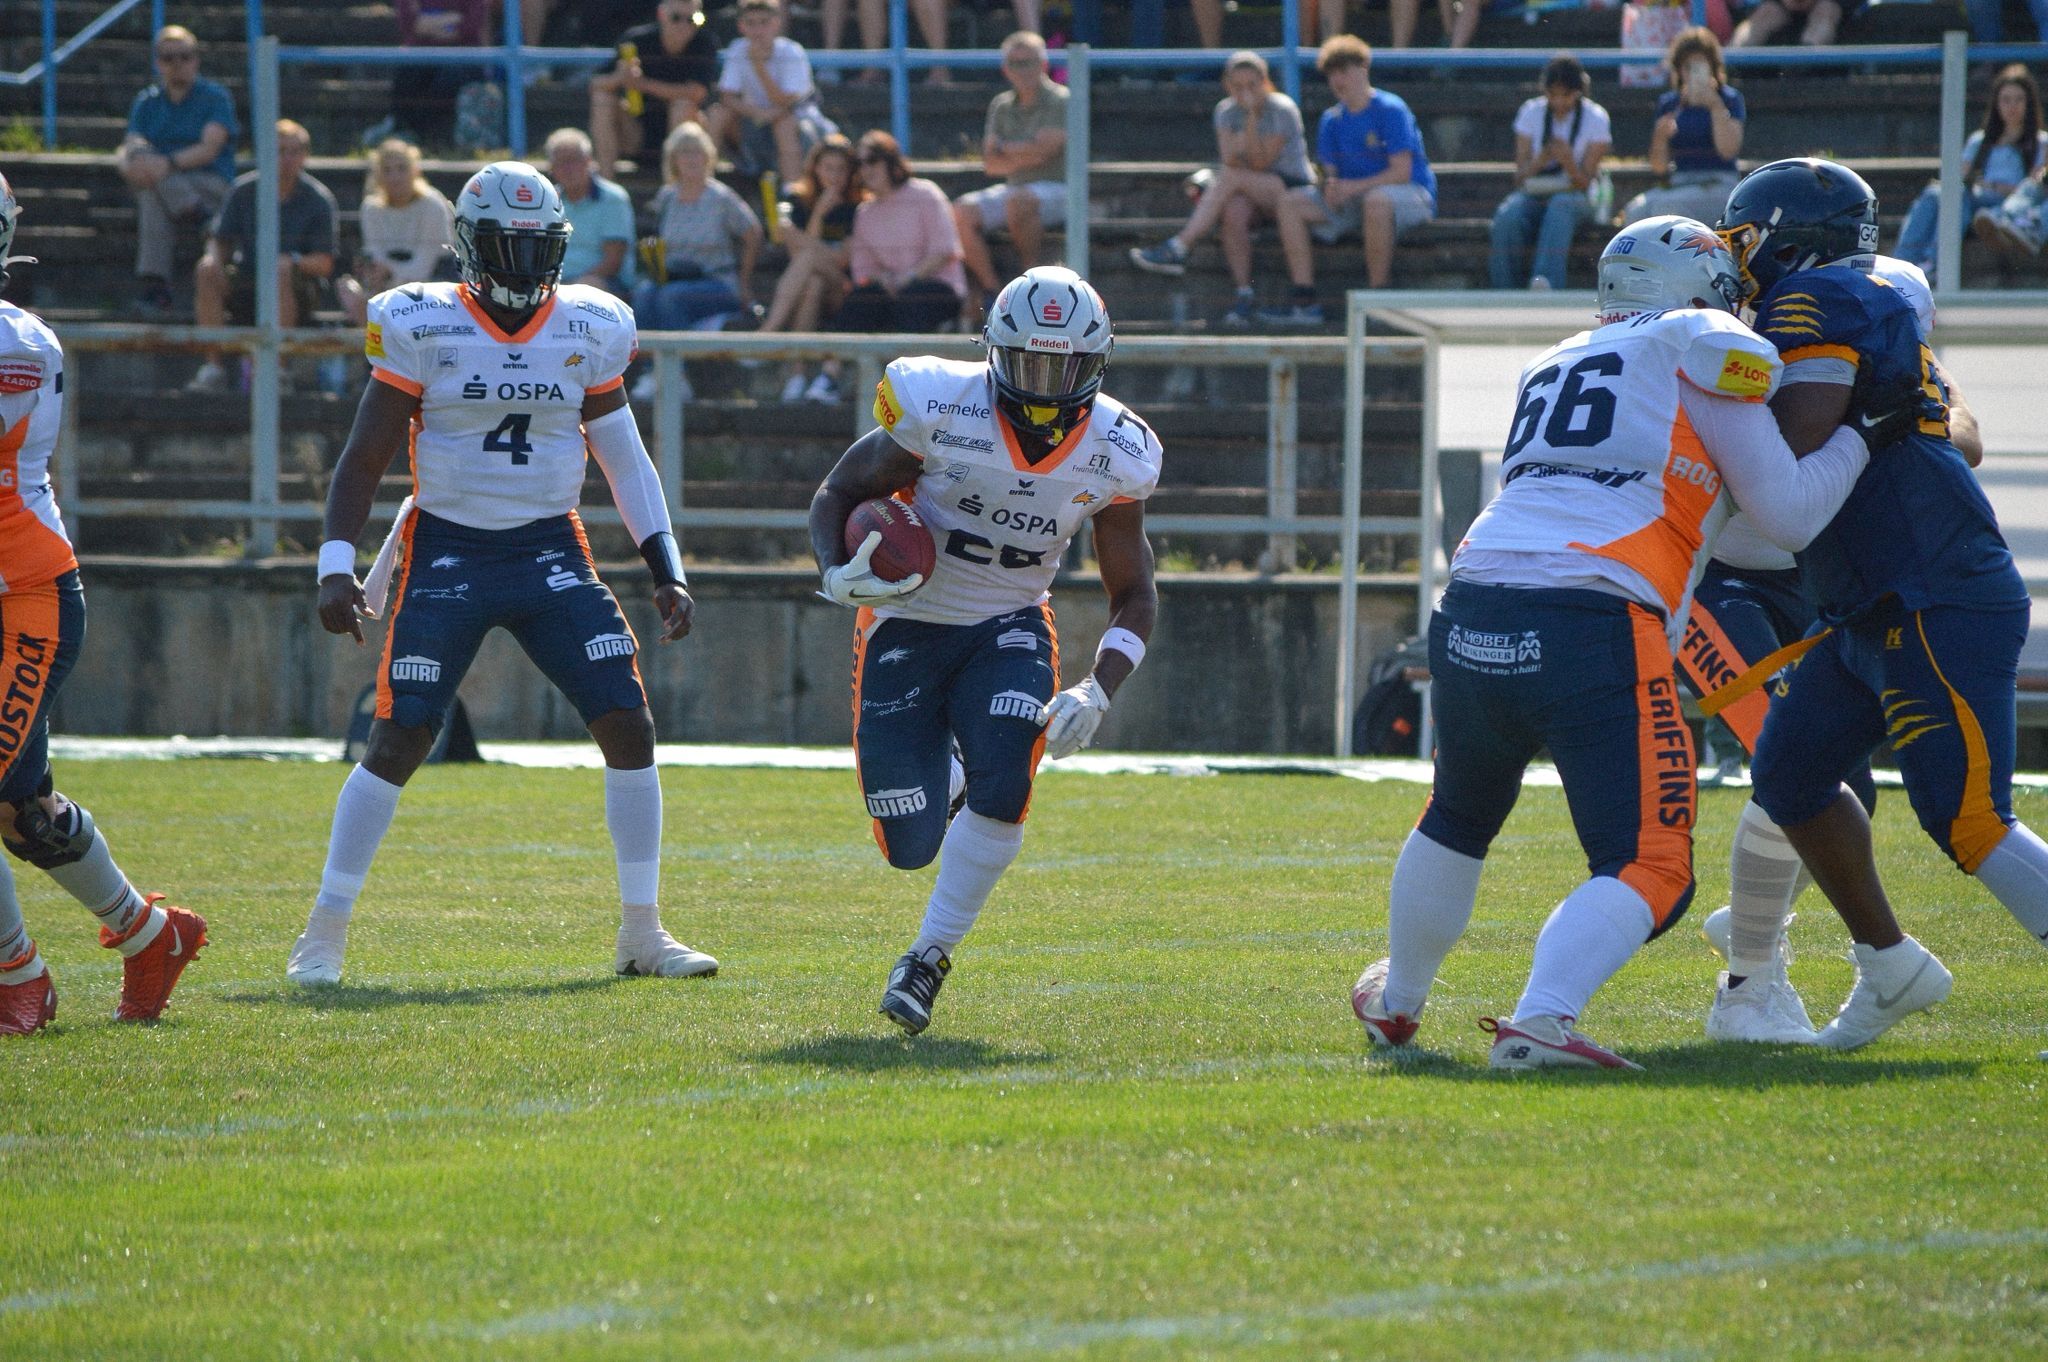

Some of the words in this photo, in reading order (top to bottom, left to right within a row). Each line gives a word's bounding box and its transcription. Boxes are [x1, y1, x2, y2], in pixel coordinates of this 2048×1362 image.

[511, 220, 541, 228] Riddell
[391, 299, 457, 319] Penneke
[569, 321, 591, 334] ETL
[1031, 338, 1069, 349] Riddell
[497, 383, 565, 401] OSPA
[1502, 352, 1624, 464] 66
[482, 413, 533, 465] 4
[1089, 454, 1111, 472] ETL
[1009, 489, 1035, 497] erima
[991, 509, 1057, 536] OSPA
[585, 640, 635, 661] WIRO
[392, 663, 441, 682] WIRO
[1648, 677, 1690, 827] GRIFFINS
[867, 788, 926, 818] WIRO
